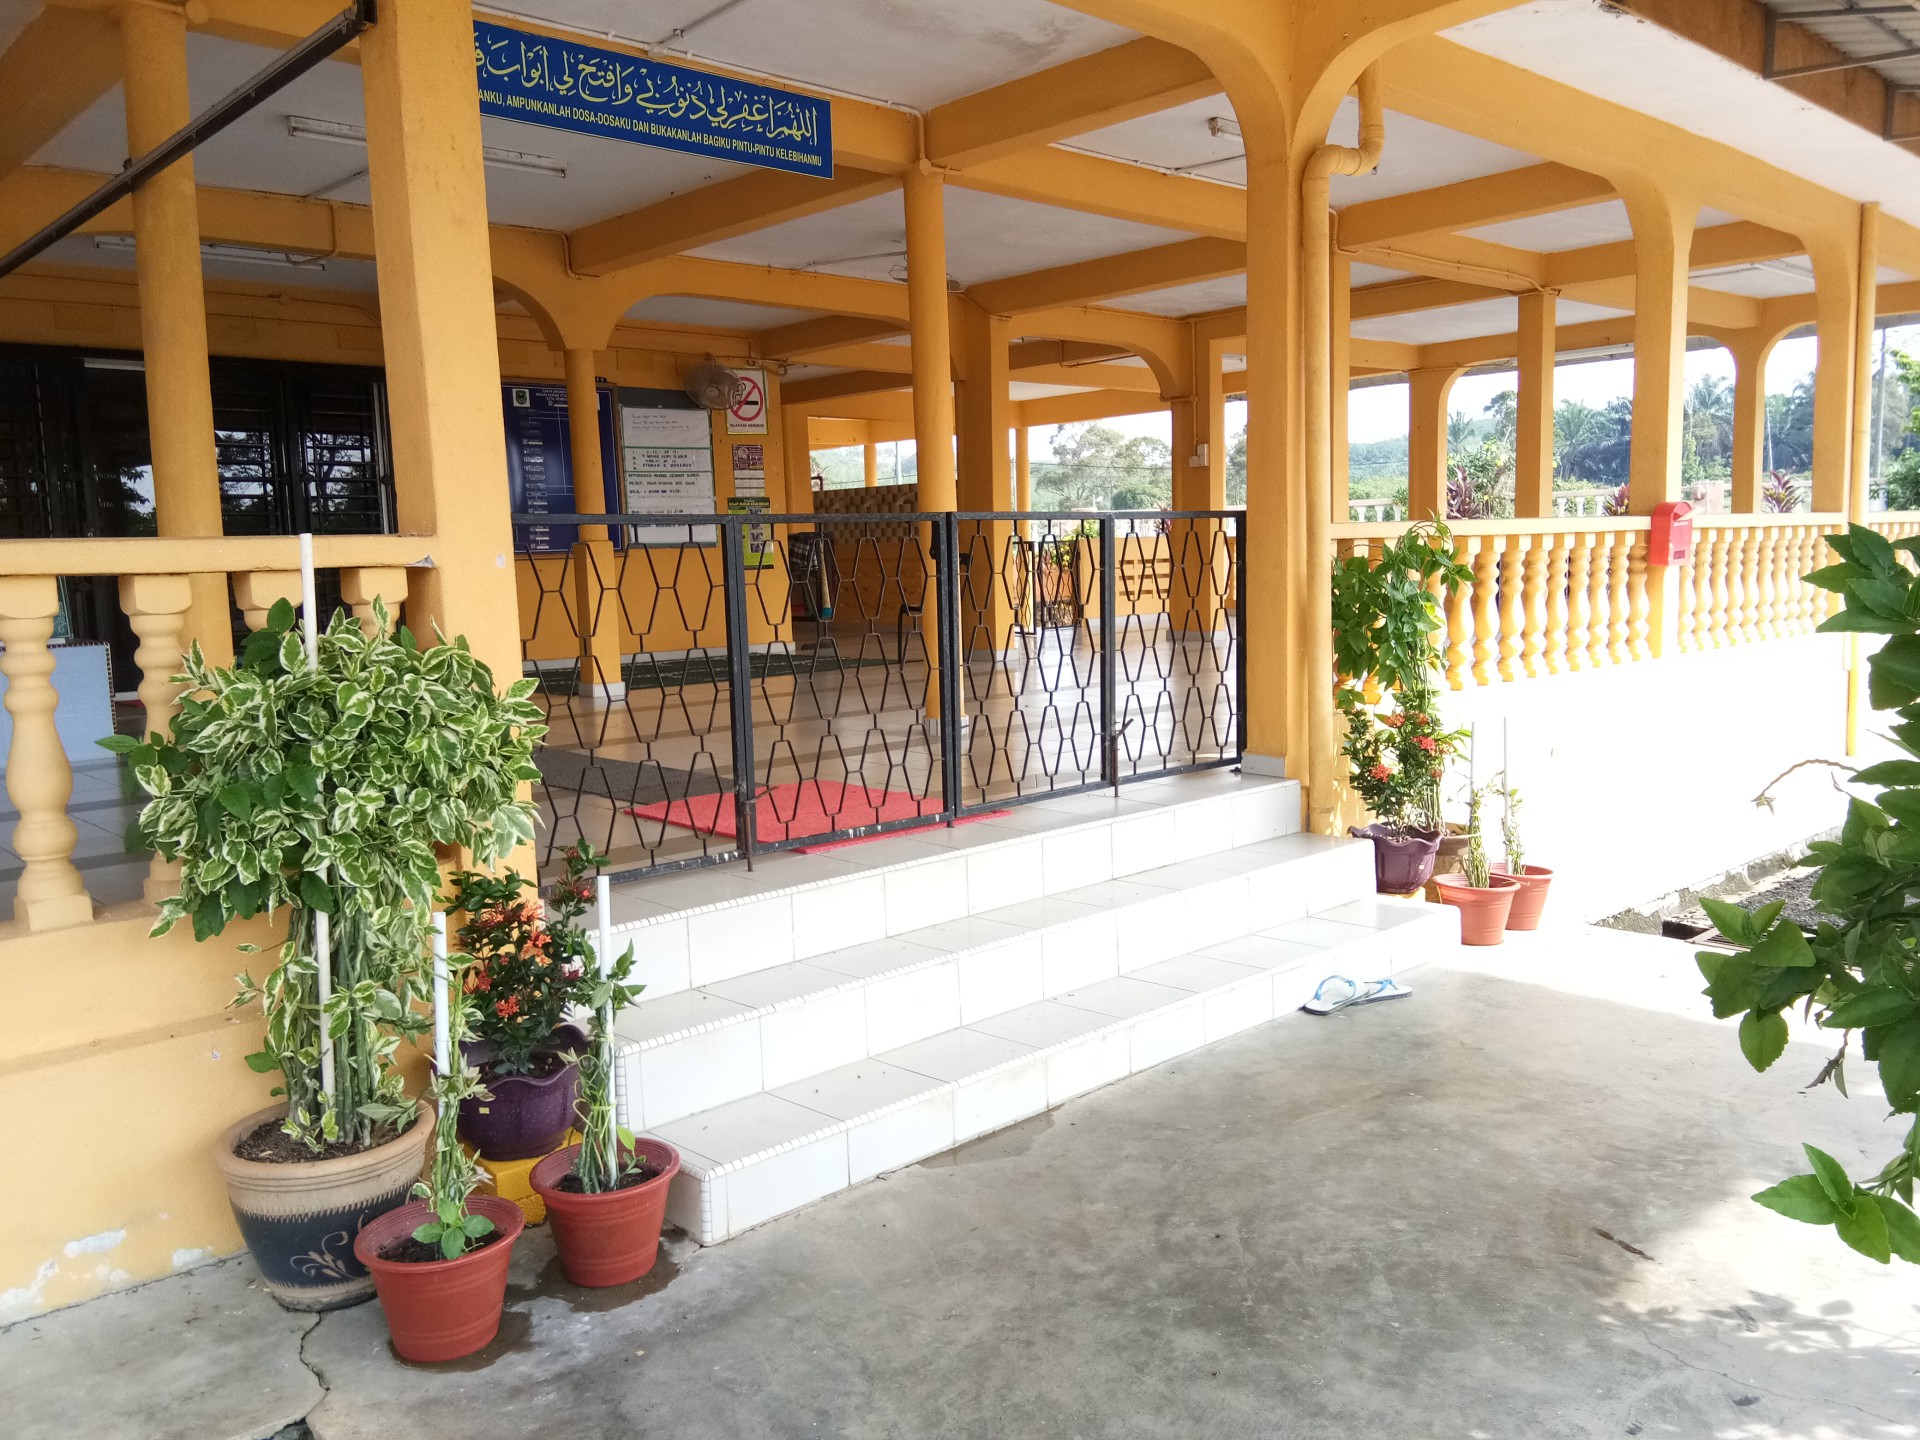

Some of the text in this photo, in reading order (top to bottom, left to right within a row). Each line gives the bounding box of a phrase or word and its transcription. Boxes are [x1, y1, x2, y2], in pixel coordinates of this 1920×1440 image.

[506, 94, 571, 118] AMPUNKANLAH
[572, 107, 631, 130] DOSA-DOSAKU
[632, 119, 649, 134] DAN
[650, 122, 702, 144] BUKAKANLAH
[703, 134, 731, 150] BAGIKU
[732, 139, 775, 158] PINTU-PINTU
[775, 147, 822, 167] KELEBIHANMU
